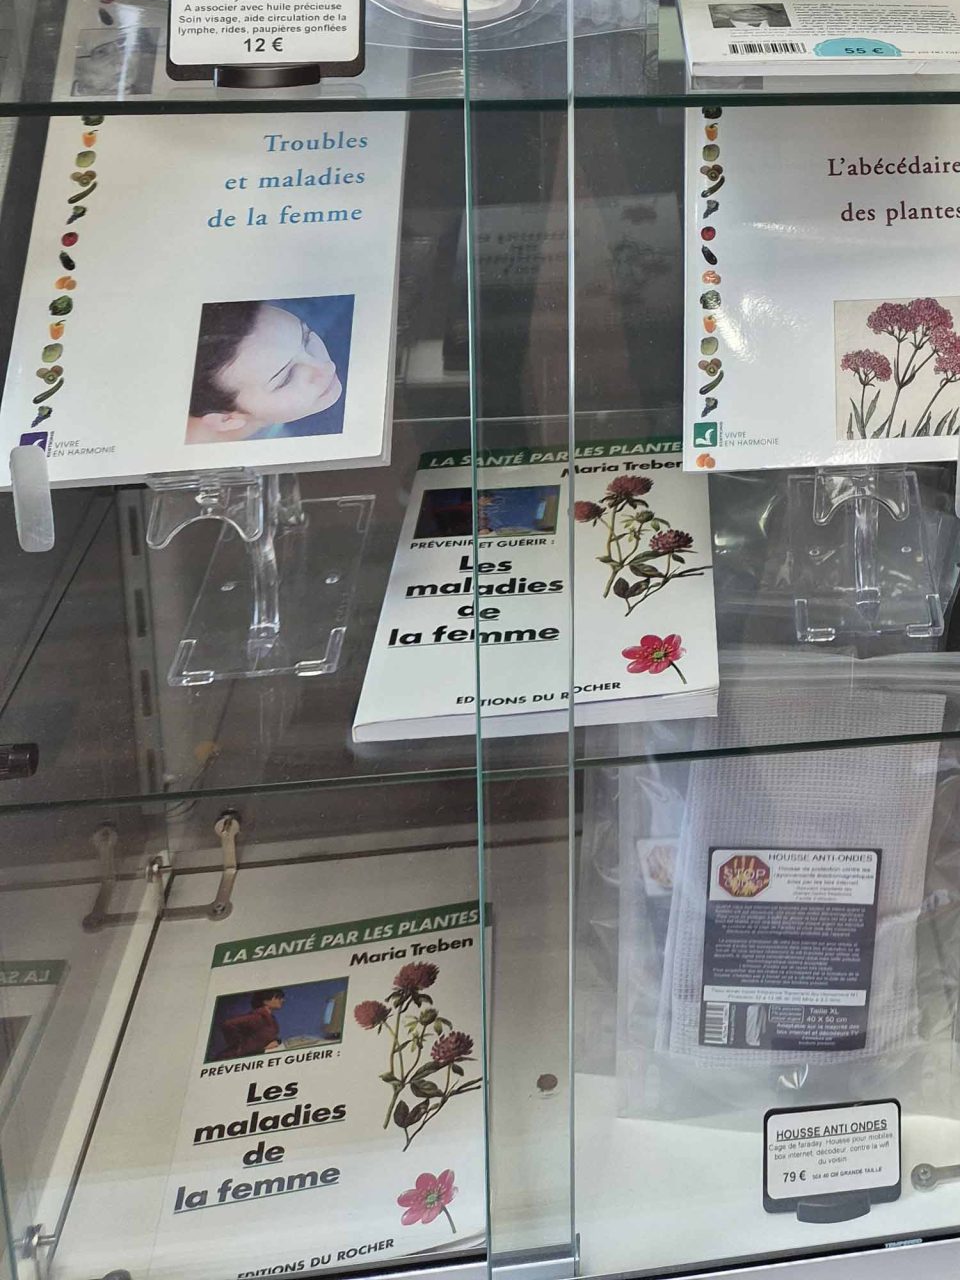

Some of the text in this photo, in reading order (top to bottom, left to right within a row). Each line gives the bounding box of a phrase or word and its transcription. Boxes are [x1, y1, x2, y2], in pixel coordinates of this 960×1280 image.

[178, 16, 202, 24] Soin
[244, 14, 265, 22] aide
[267, 14, 320, 22] circulation
[323, 13, 336, 21] de
[338, 13, 347, 21] la
[184, 4, 192, 12] A
[194, 4, 237, 12] associer
[266, 3, 291, 11] huile
[294, 3, 342, 12] précieuse
[178, 24, 347, 36] lymphe, rides, paupières gonflées
[243, 37, 284, 52] 12 €
[844, 46, 884, 56] 55 €
[263, 131, 369, 152] Troubles
[225, 167, 366, 190] et maladies
[207, 205, 363, 228] de la femme
[840, 202, 878, 222] des
[221, 909, 480, 965] LA SANTÉ PAR LES PLANTES
[350, 935, 474, 968] Maria Treben
[200, 1049, 334, 1079] PRÉVENIR ET GUÉRIR
[247, 1078, 300, 1104] Les
[194, 1101, 347, 1143] maladies
[776, 1118, 888, 1141] HOUSSE ANTI ONDES
[243, 1143, 285, 1168] de
[783, 1170, 807, 1183] 79 €
[174, 1166, 341, 1213] la femme
